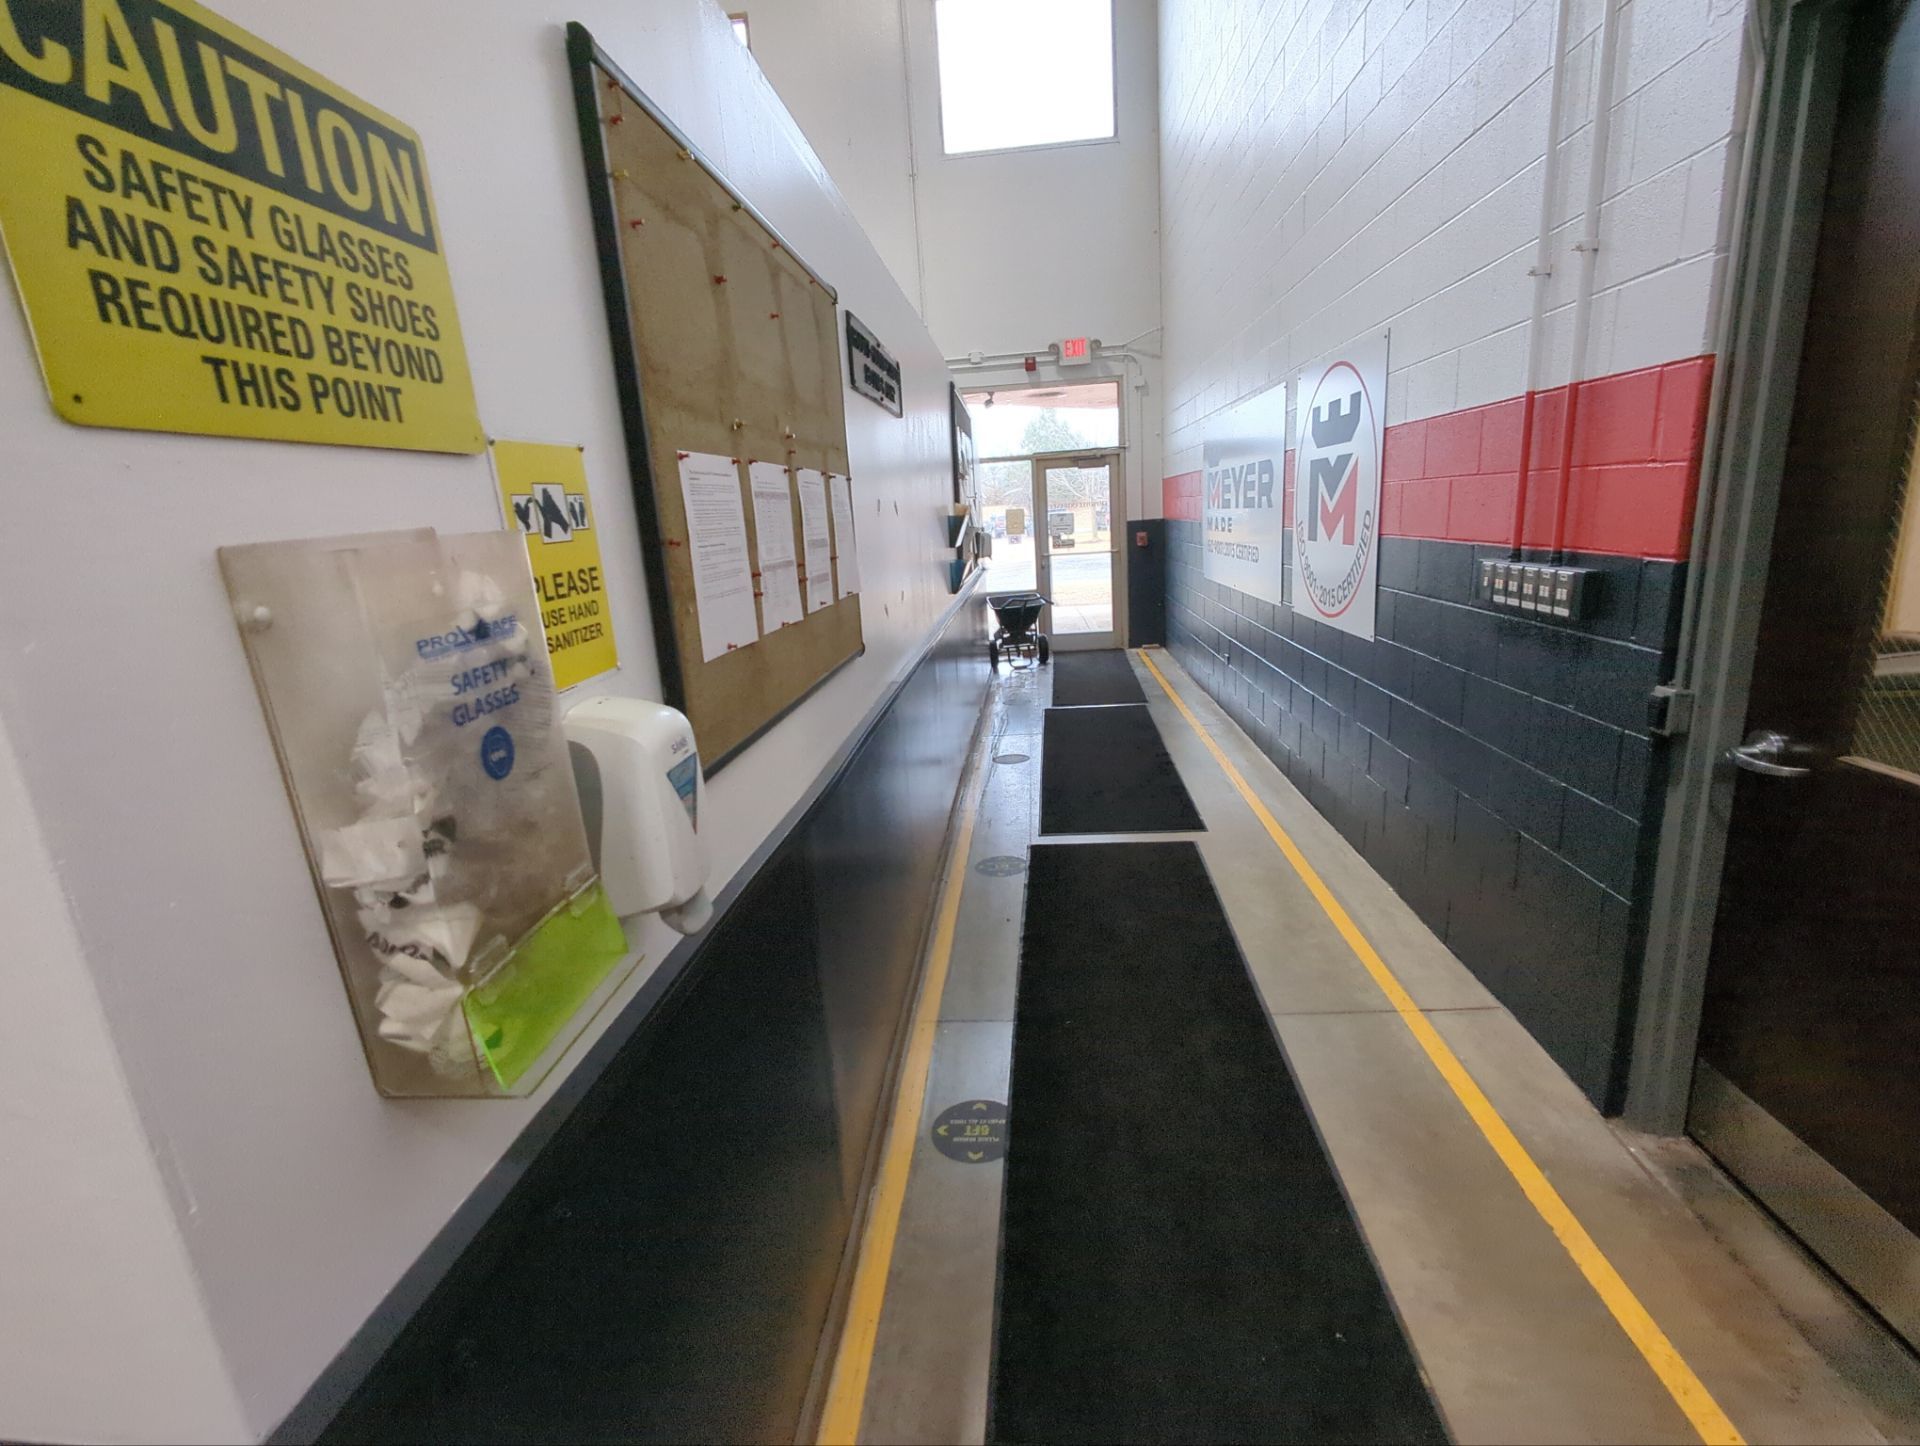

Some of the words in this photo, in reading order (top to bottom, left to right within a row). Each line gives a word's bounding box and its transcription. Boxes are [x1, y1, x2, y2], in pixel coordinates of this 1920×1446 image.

[76, 133, 254, 239] SAFETY
[269, 205, 413, 290] GLASSES
[66, 196, 180, 274] AND
[193, 235, 335, 315] SAFETY
[346, 283, 440, 341] SHOES
[88, 269, 314, 360] REQUIRED
[323, 325, 444, 384] BEYOND
[1064, 336, 1086, 358] EXIT
[201, 356, 300, 412] THIS
[307, 373, 403, 423] POINT
[1207, 459, 1274, 510] MEYER
[1207, 516, 1233, 533] MADE
[1336, 509, 1371, 605] CERTIFIED
[542, 607, 567, 629] USE
[568, 599, 599, 621] HAND
[546, 622, 604, 654] SANITIZER
[451, 657, 509, 695] SAFETY
[452, 683, 520, 726] GLASSES
